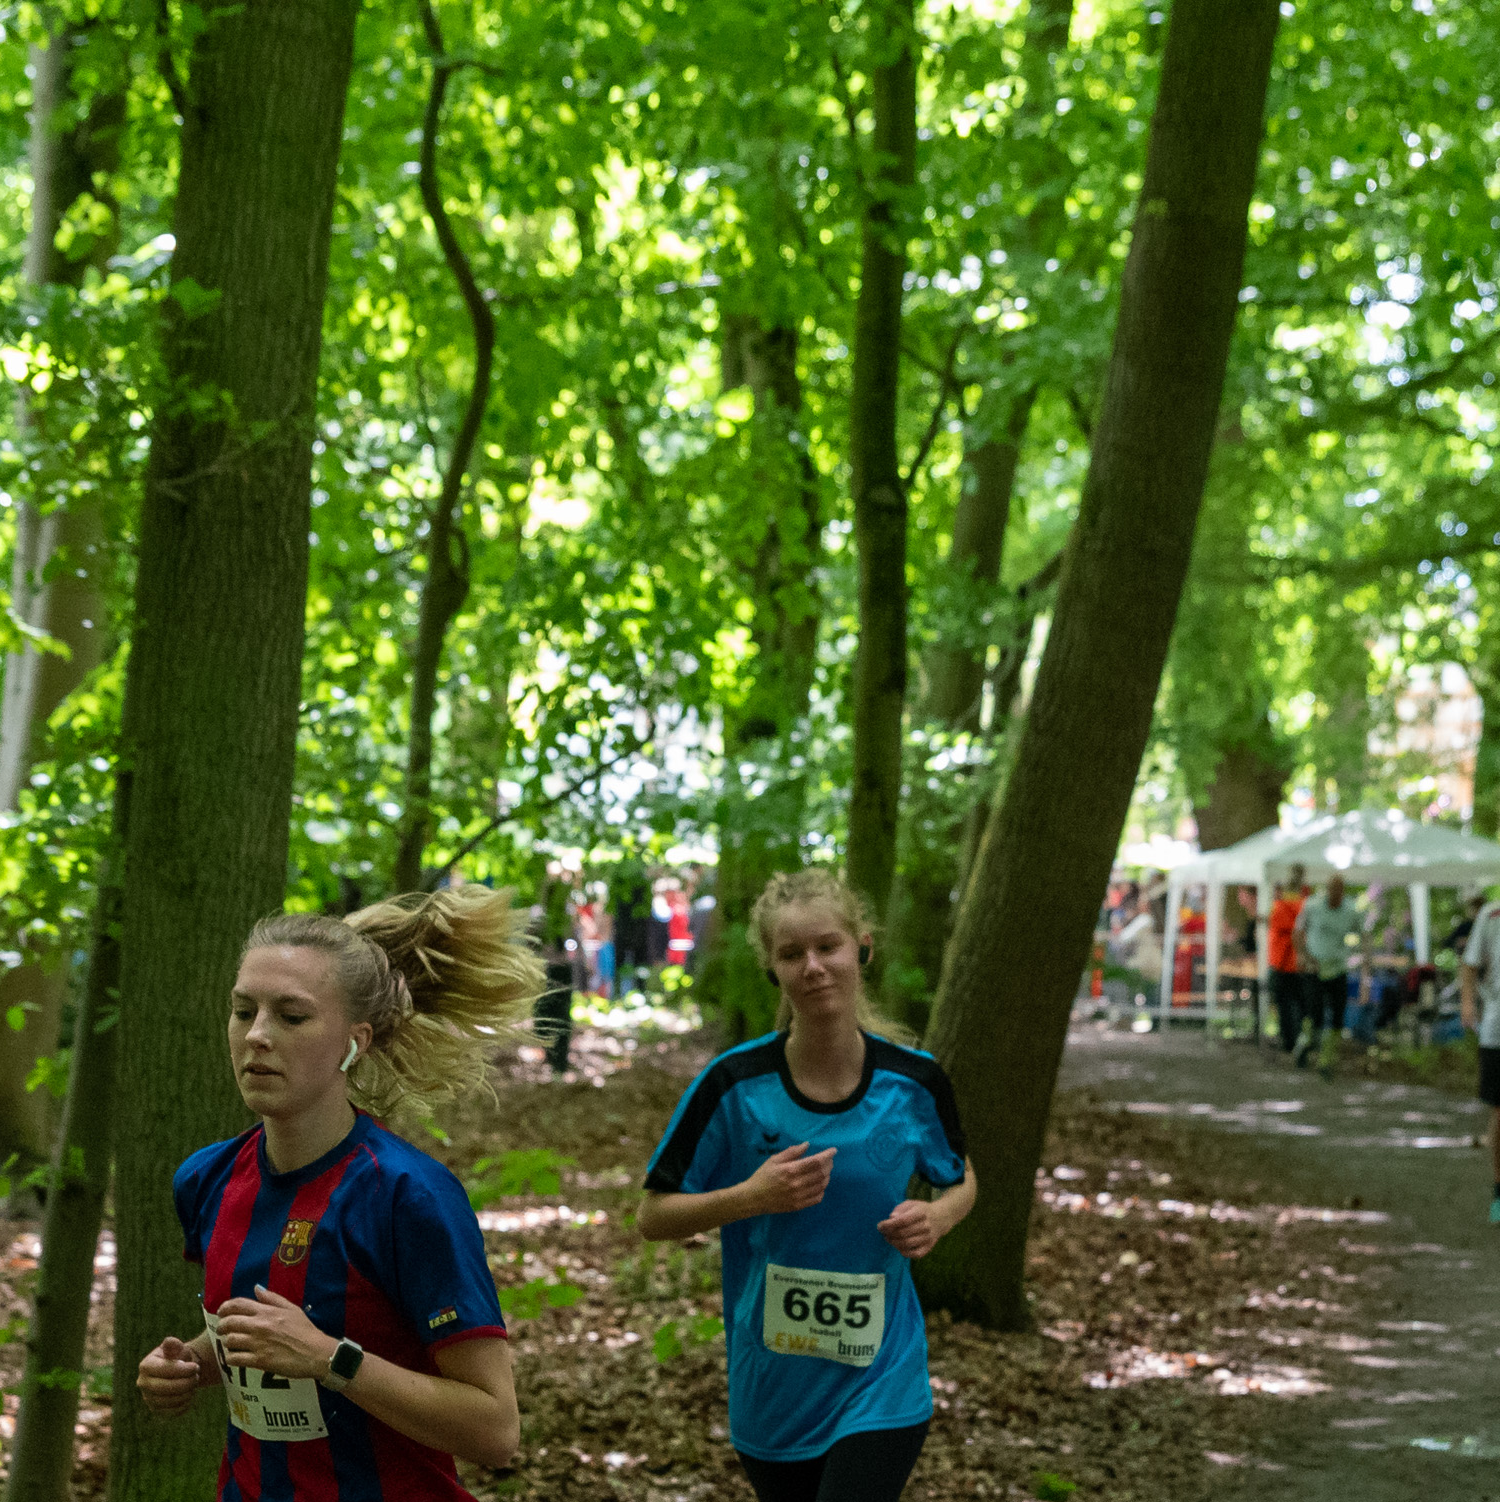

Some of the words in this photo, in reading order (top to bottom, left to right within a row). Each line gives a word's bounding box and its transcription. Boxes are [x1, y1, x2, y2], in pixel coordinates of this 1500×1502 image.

[783, 1287, 871, 1329] 665
[838, 1338, 875, 1356] bruns
[262, 1405, 310, 1427] bruns
